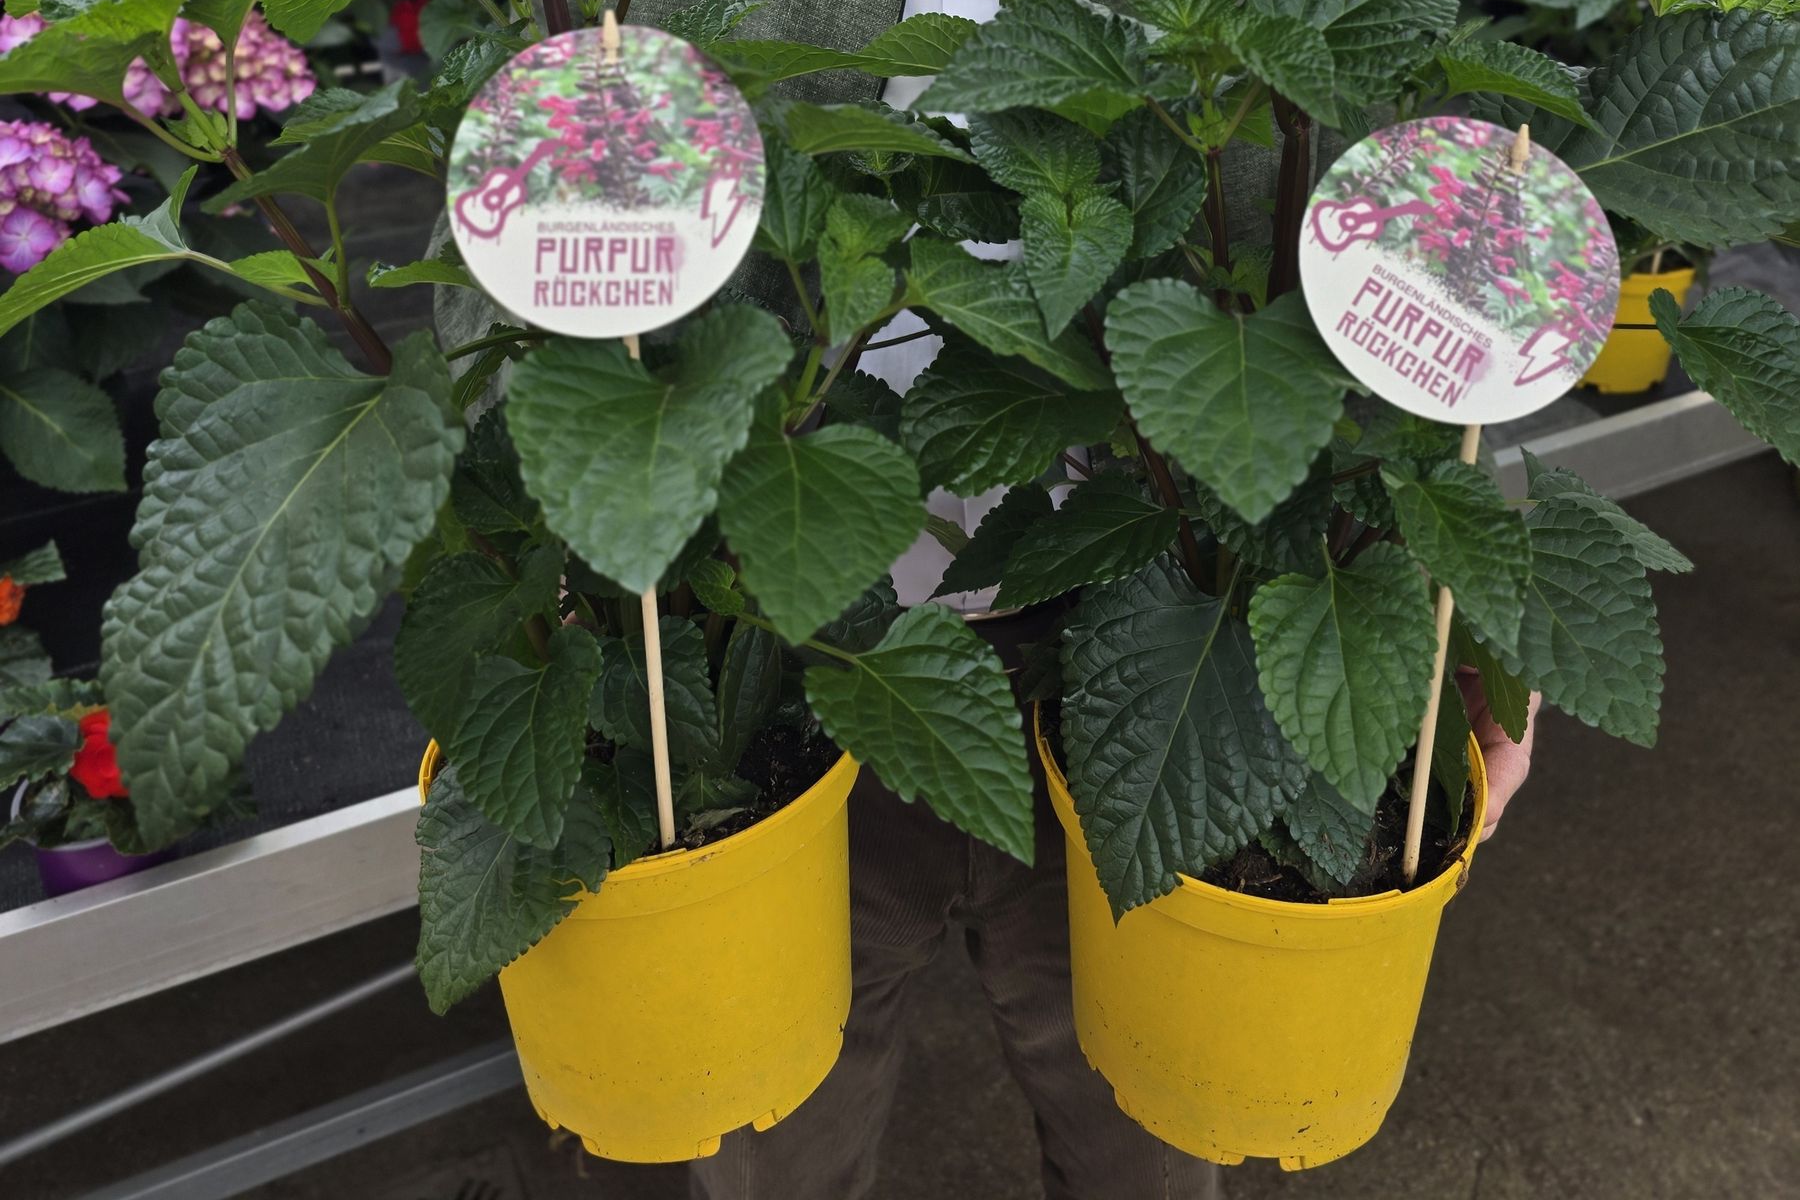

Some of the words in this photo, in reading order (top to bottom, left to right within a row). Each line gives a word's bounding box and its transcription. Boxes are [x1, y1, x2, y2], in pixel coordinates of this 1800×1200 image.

[535, 237, 676, 274] PURPUR
[537, 220, 676, 234] BURGENLÄNDISCHES
[534, 276, 674, 307] RÖCKCHEN
[1372, 263, 1494, 349] BURGENLÄNDISCHES
[1335, 310, 1465, 409] RÖCKCHEN
[1351, 277, 1486, 382] PURPUR
